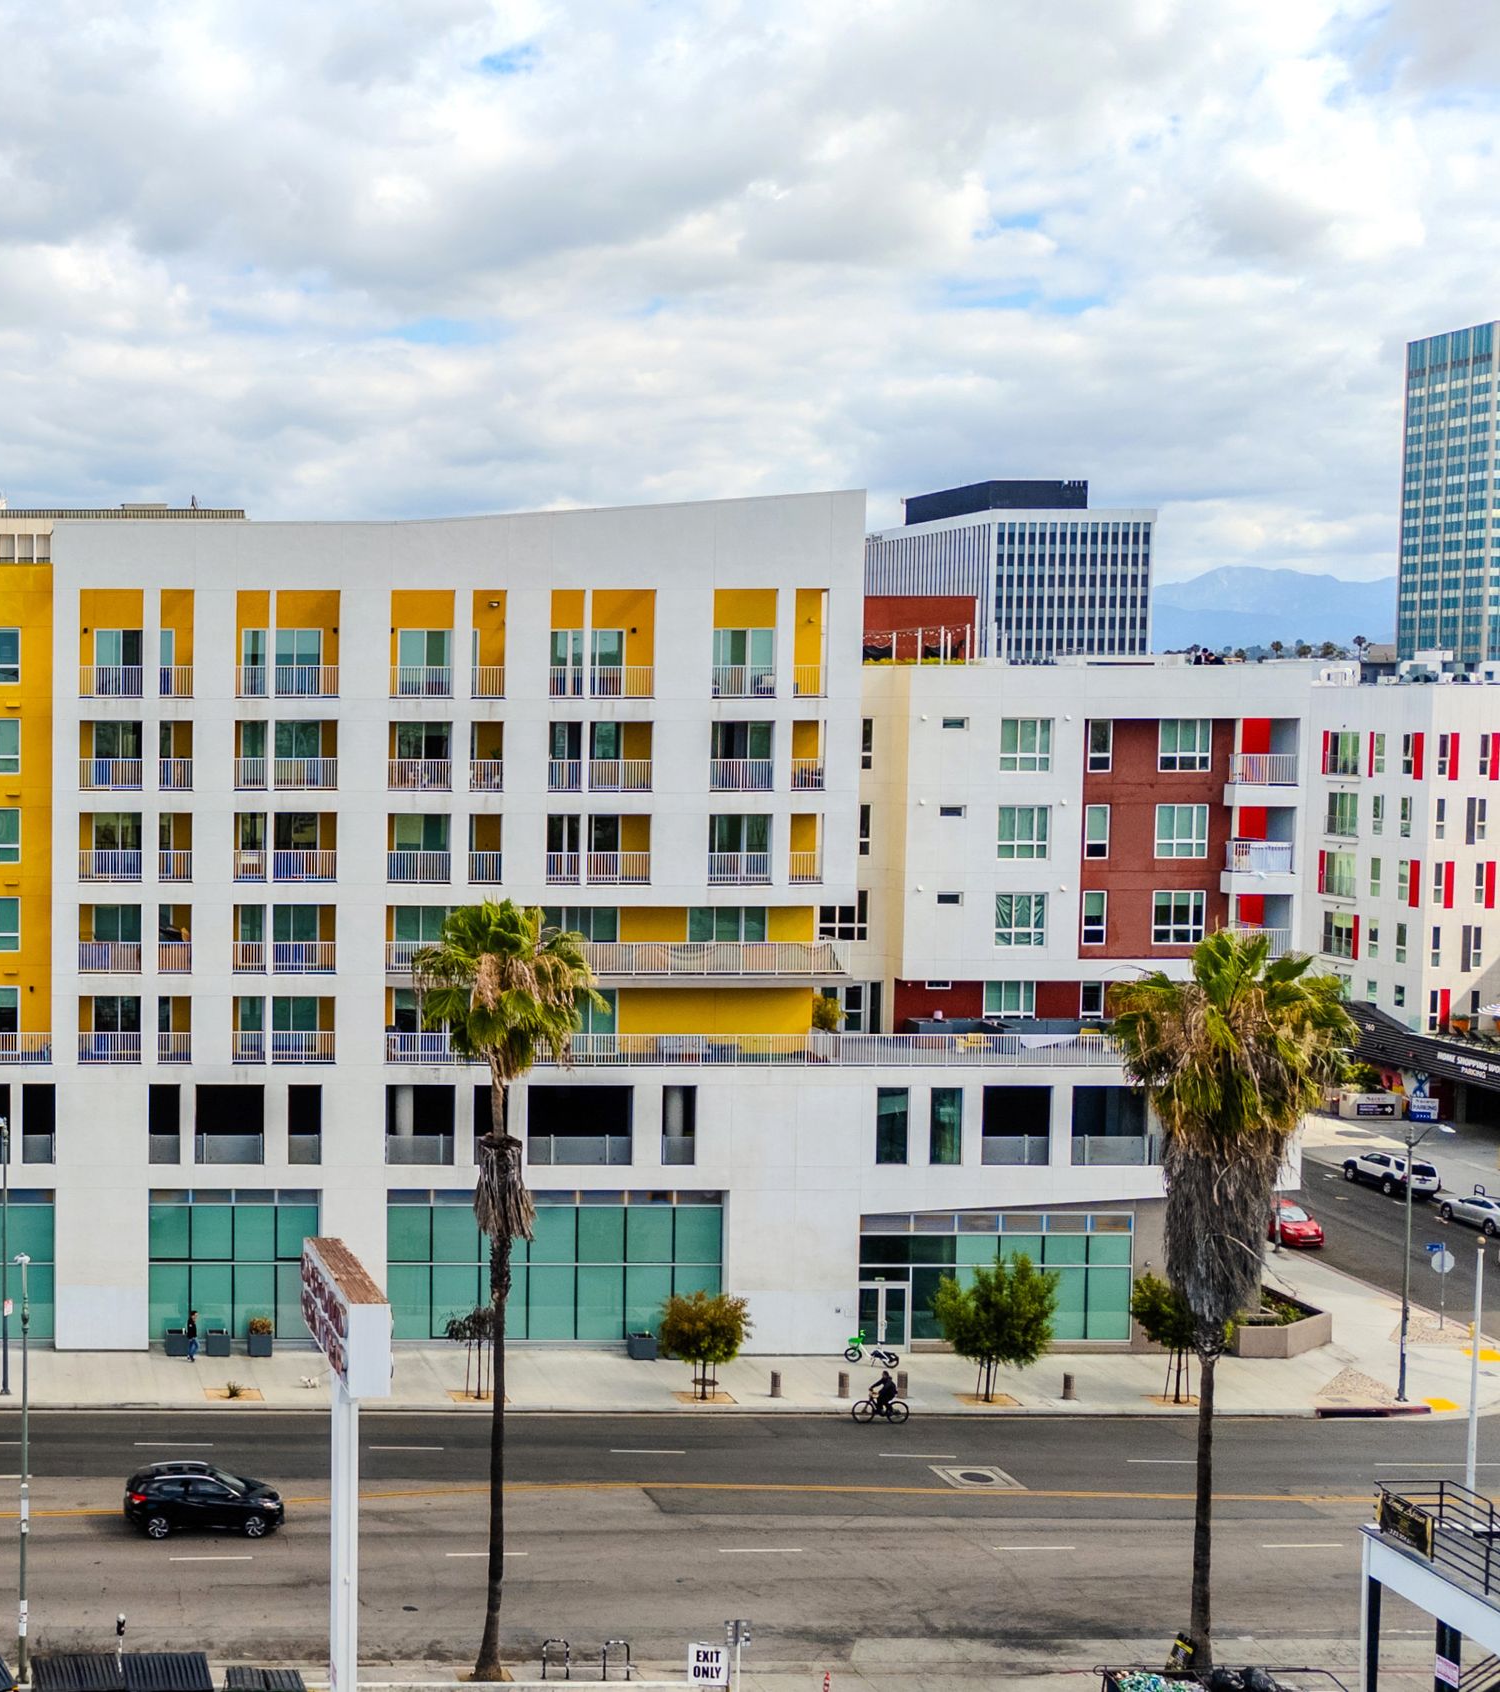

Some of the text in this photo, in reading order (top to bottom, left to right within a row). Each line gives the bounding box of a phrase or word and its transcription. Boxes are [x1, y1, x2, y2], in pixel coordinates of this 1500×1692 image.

[1437, 1051, 1456, 1063] HOME
[1457, 1056, 1488, 1070] SHOPPING
[1461, 1066, 1487, 1079] PARKING
[696, 1650, 721, 1663] EXIT
[693, 1665, 722, 1679] ONLY
